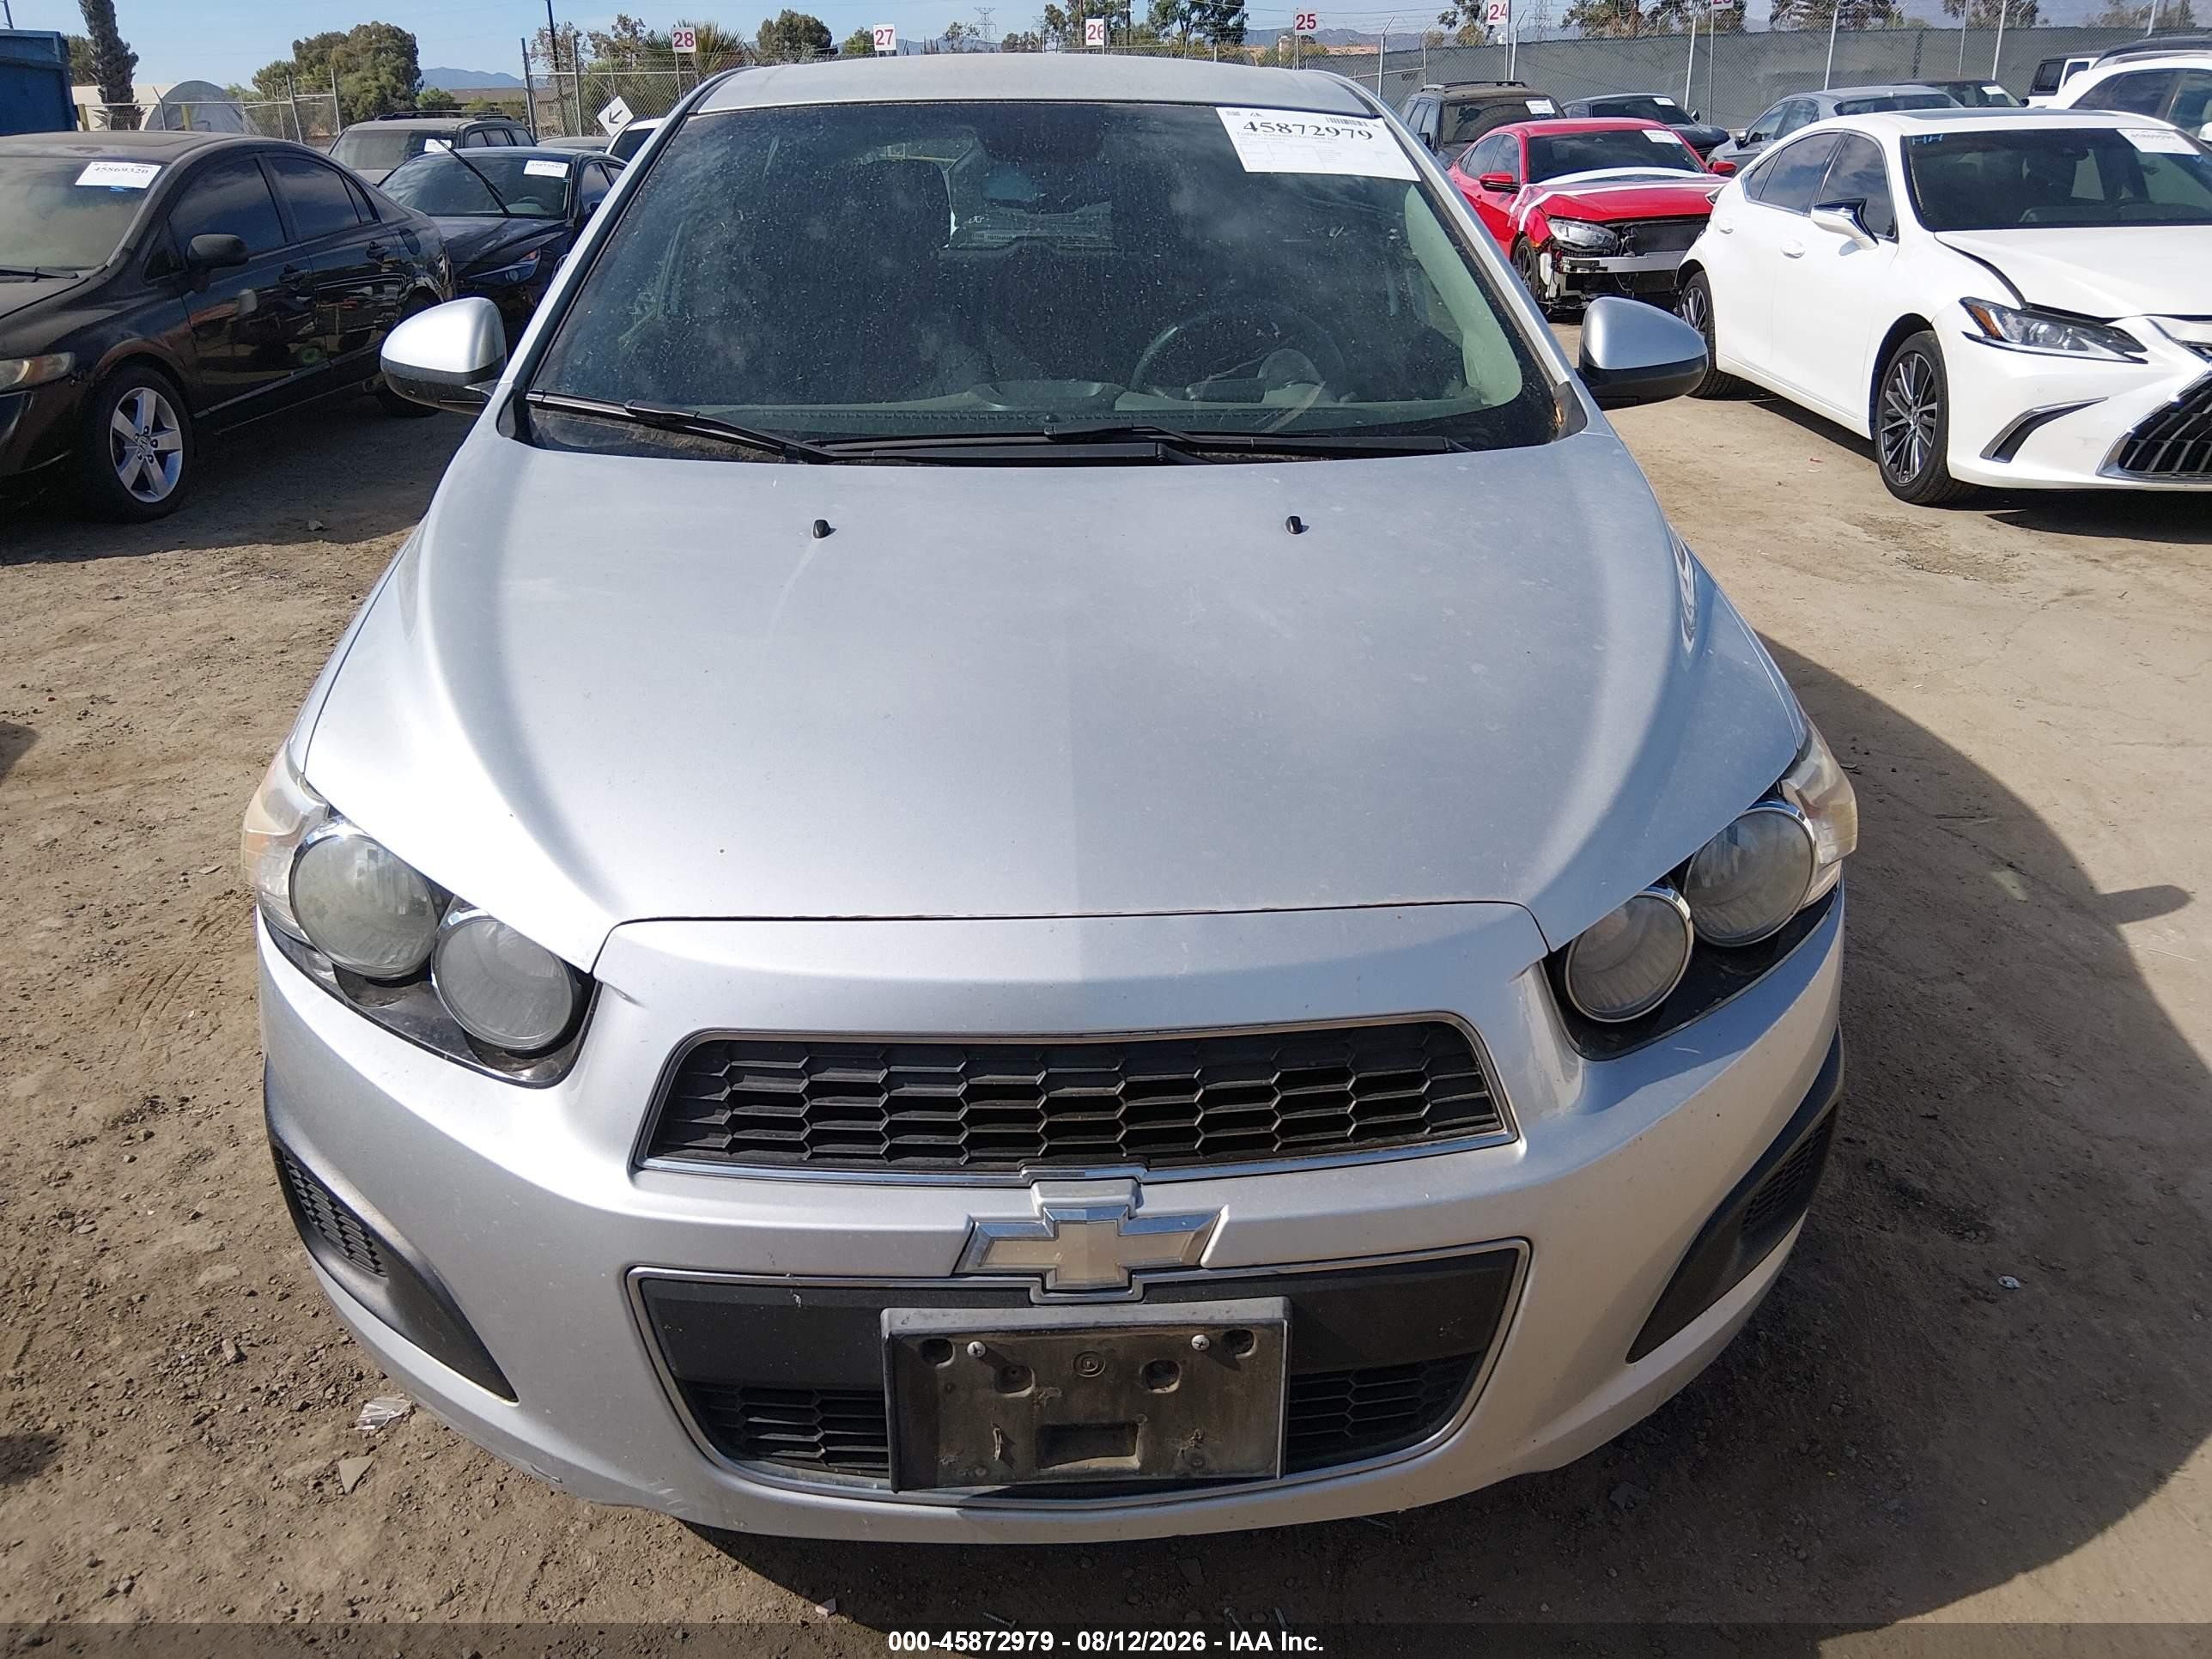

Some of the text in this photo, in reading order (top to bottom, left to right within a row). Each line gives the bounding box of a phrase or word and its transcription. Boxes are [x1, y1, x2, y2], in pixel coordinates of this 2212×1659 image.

[1489, 3, 1507, 20] 24
[1296, 14, 1316, 30] 25
[673, 31, 695, 48] 28
[875, 28, 894, 46] 27
[1243, 120, 1374, 141] 45872979
